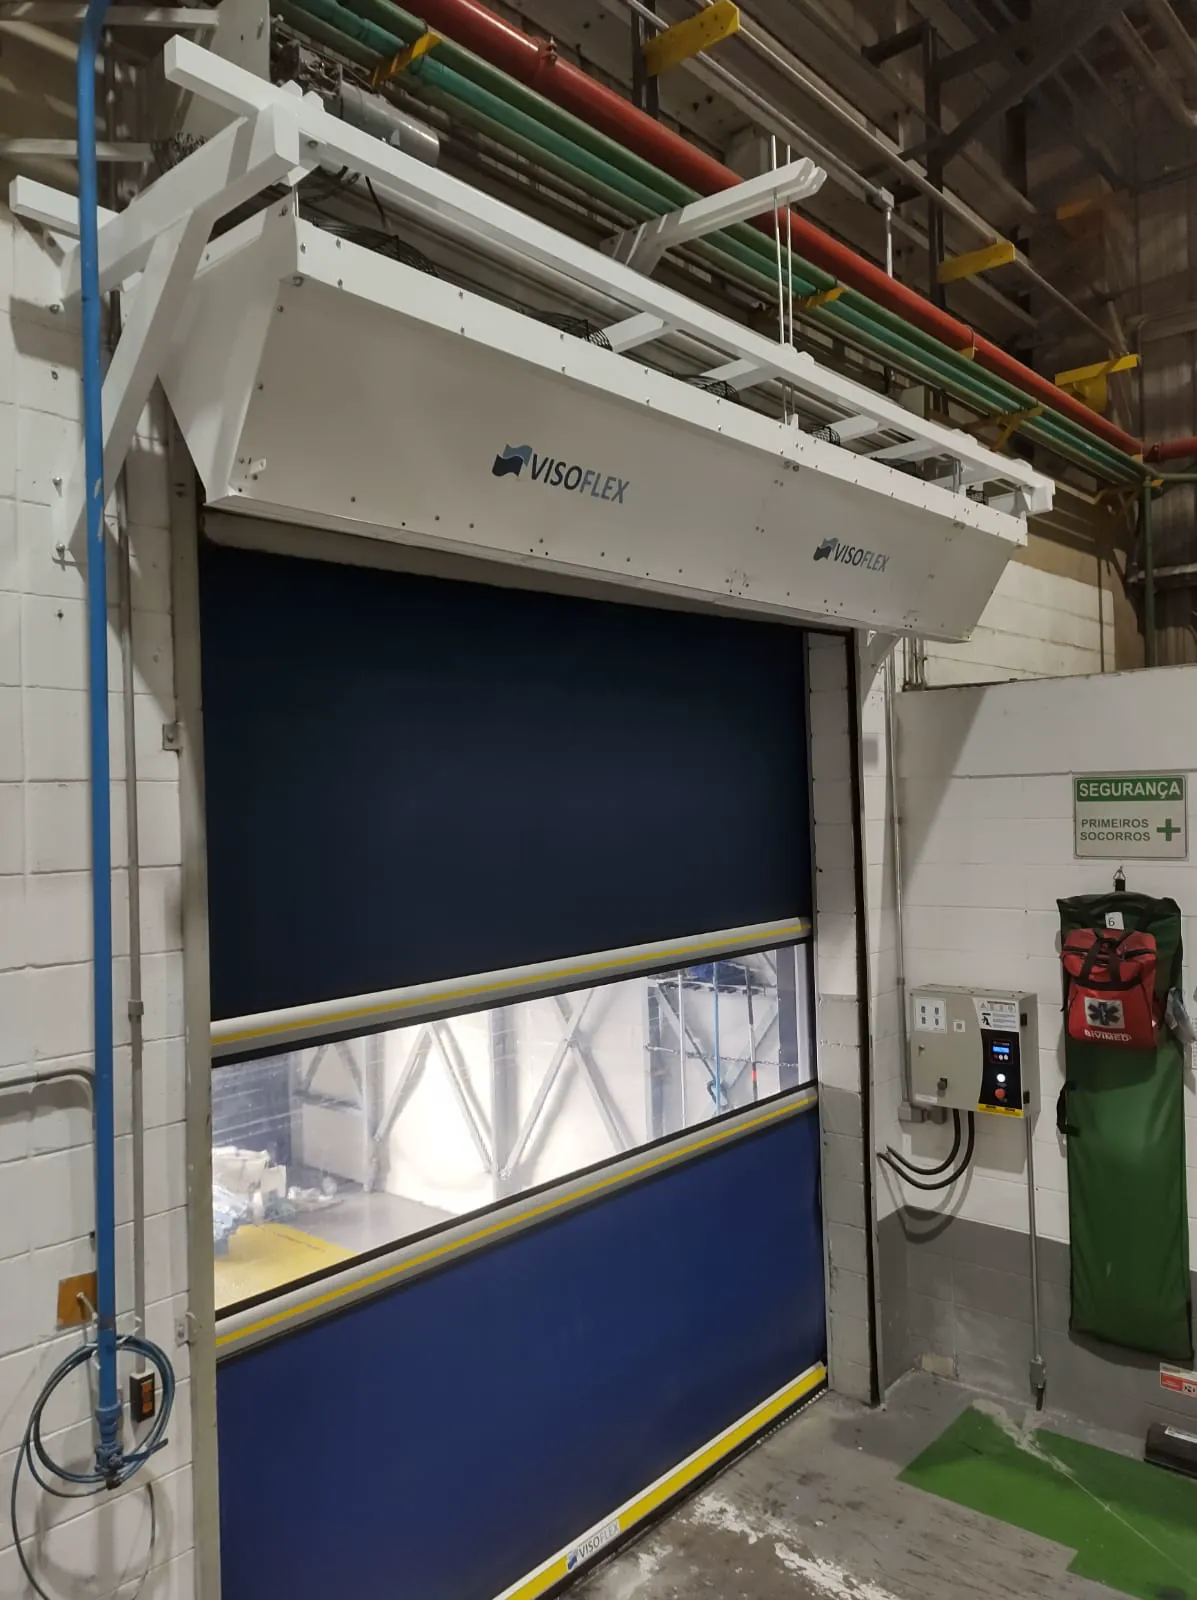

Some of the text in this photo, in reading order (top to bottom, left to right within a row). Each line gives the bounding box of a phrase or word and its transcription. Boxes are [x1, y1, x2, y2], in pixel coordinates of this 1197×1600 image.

[531, 453, 630, 504] VISOFLEX
[834, 543, 890, 572] VISOFLEX
[1079, 781, 1181, 800] SEGURANÇA
[1081, 818, 1149, 828] PRIMEIROS
[1080, 831, 1151, 842] SOCORROS
[578, 1522, 619, 1558] VISOFLEX
